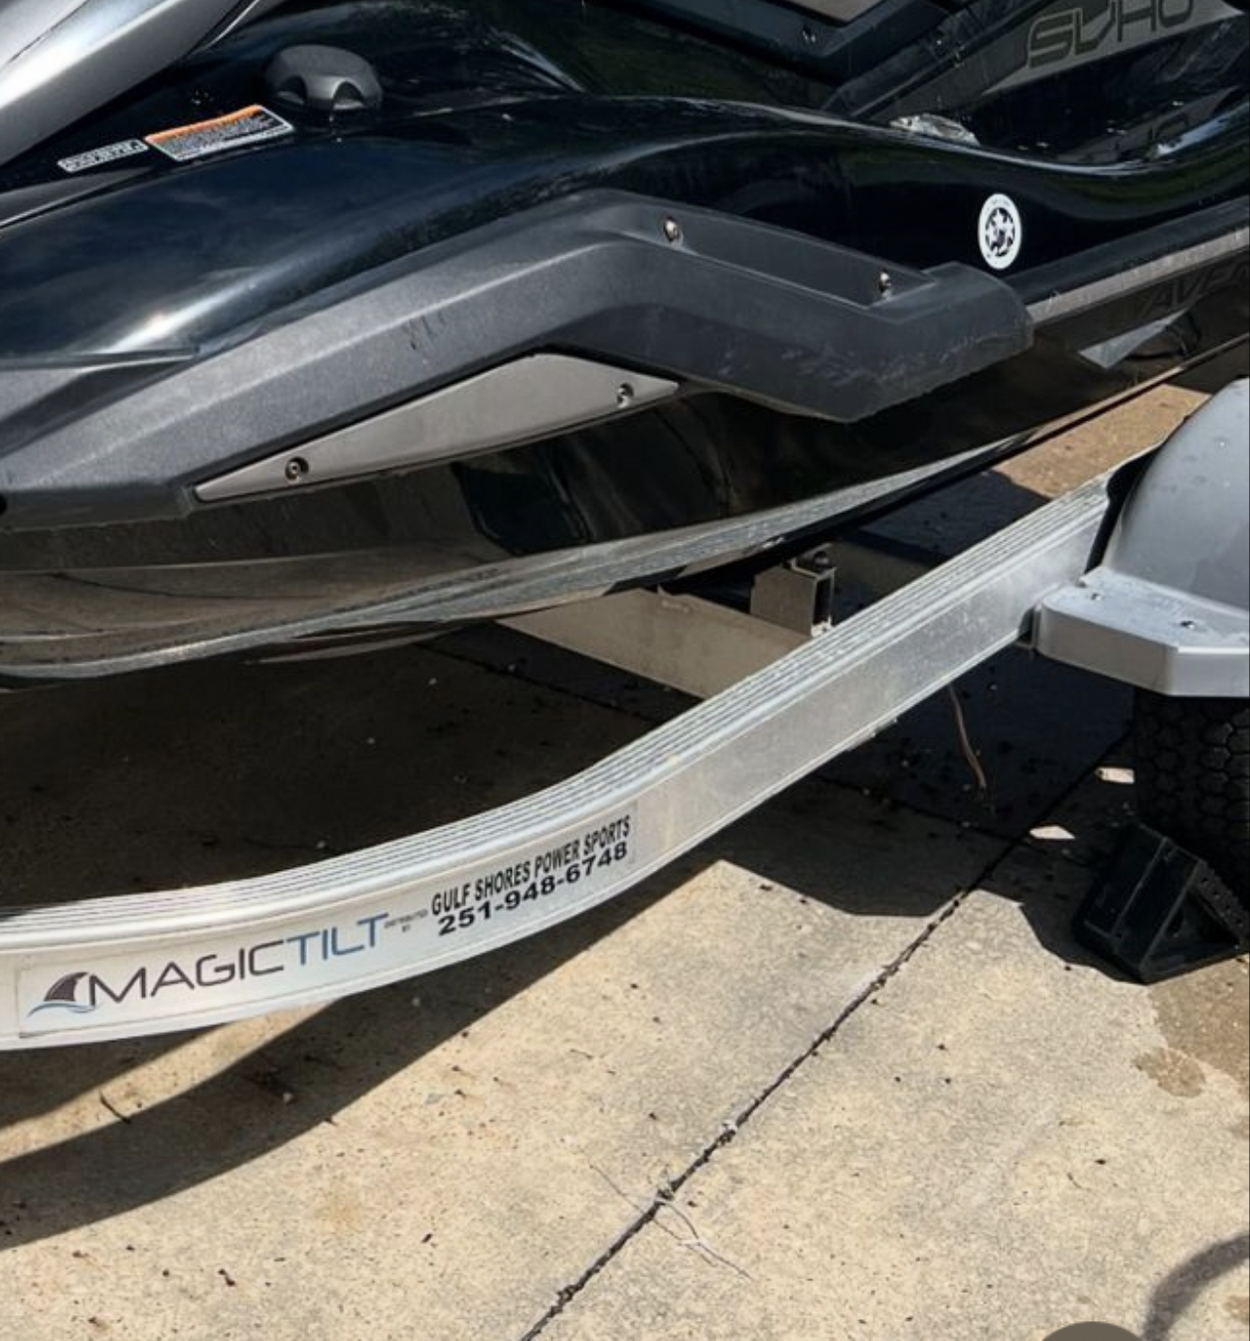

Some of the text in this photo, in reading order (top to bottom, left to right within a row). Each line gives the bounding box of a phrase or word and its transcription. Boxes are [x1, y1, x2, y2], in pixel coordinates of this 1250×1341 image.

[431, 815, 630, 916] GULF SHORES POWER SPORTS
[438, 842, 628, 936] 251-948-6748
